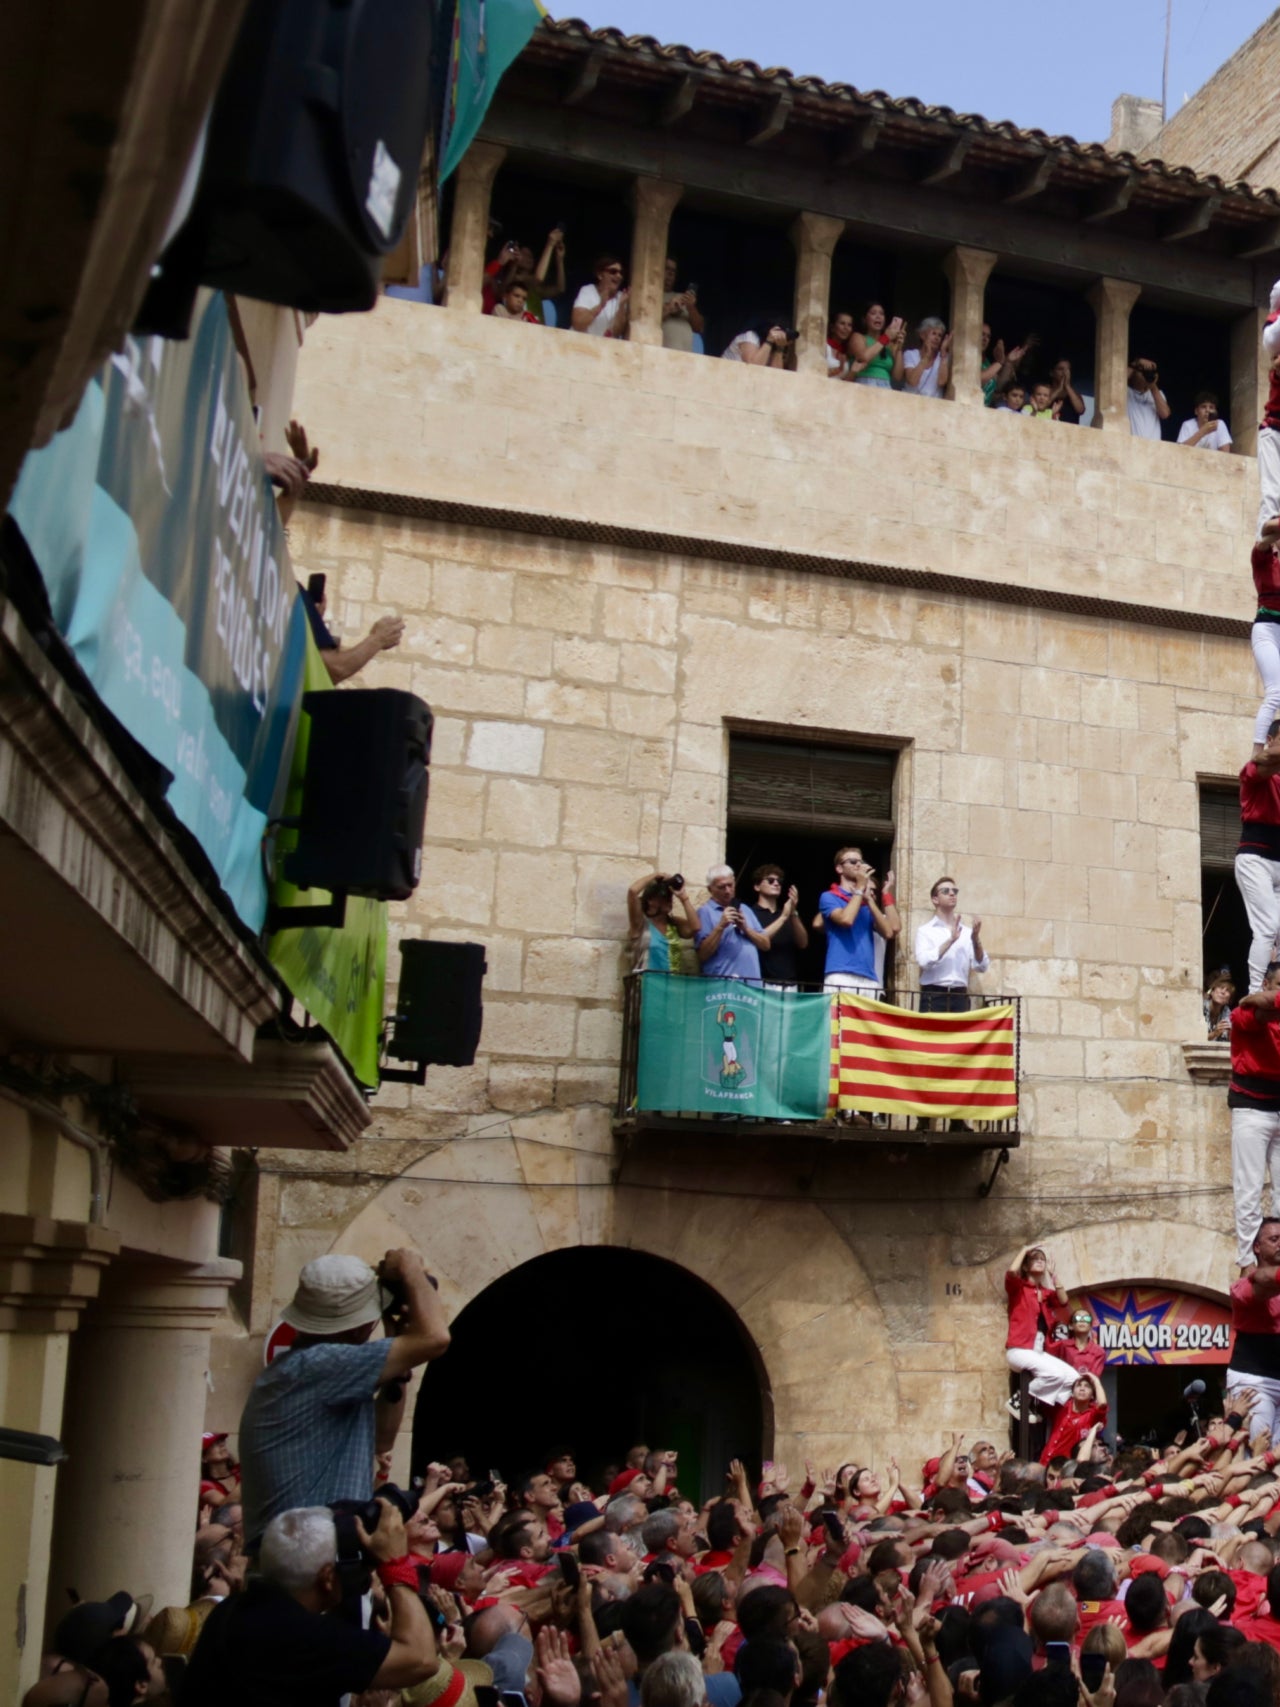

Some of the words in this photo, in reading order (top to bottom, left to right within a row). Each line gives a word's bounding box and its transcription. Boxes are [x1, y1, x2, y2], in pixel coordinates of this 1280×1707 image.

[704, 1087, 754, 1099] VILAFRANCA
[944, 1282, 962, 1296] 16
[1098, 1323, 1172, 1350] MAJOR
[1175, 1323, 1230, 1350] 2024!
